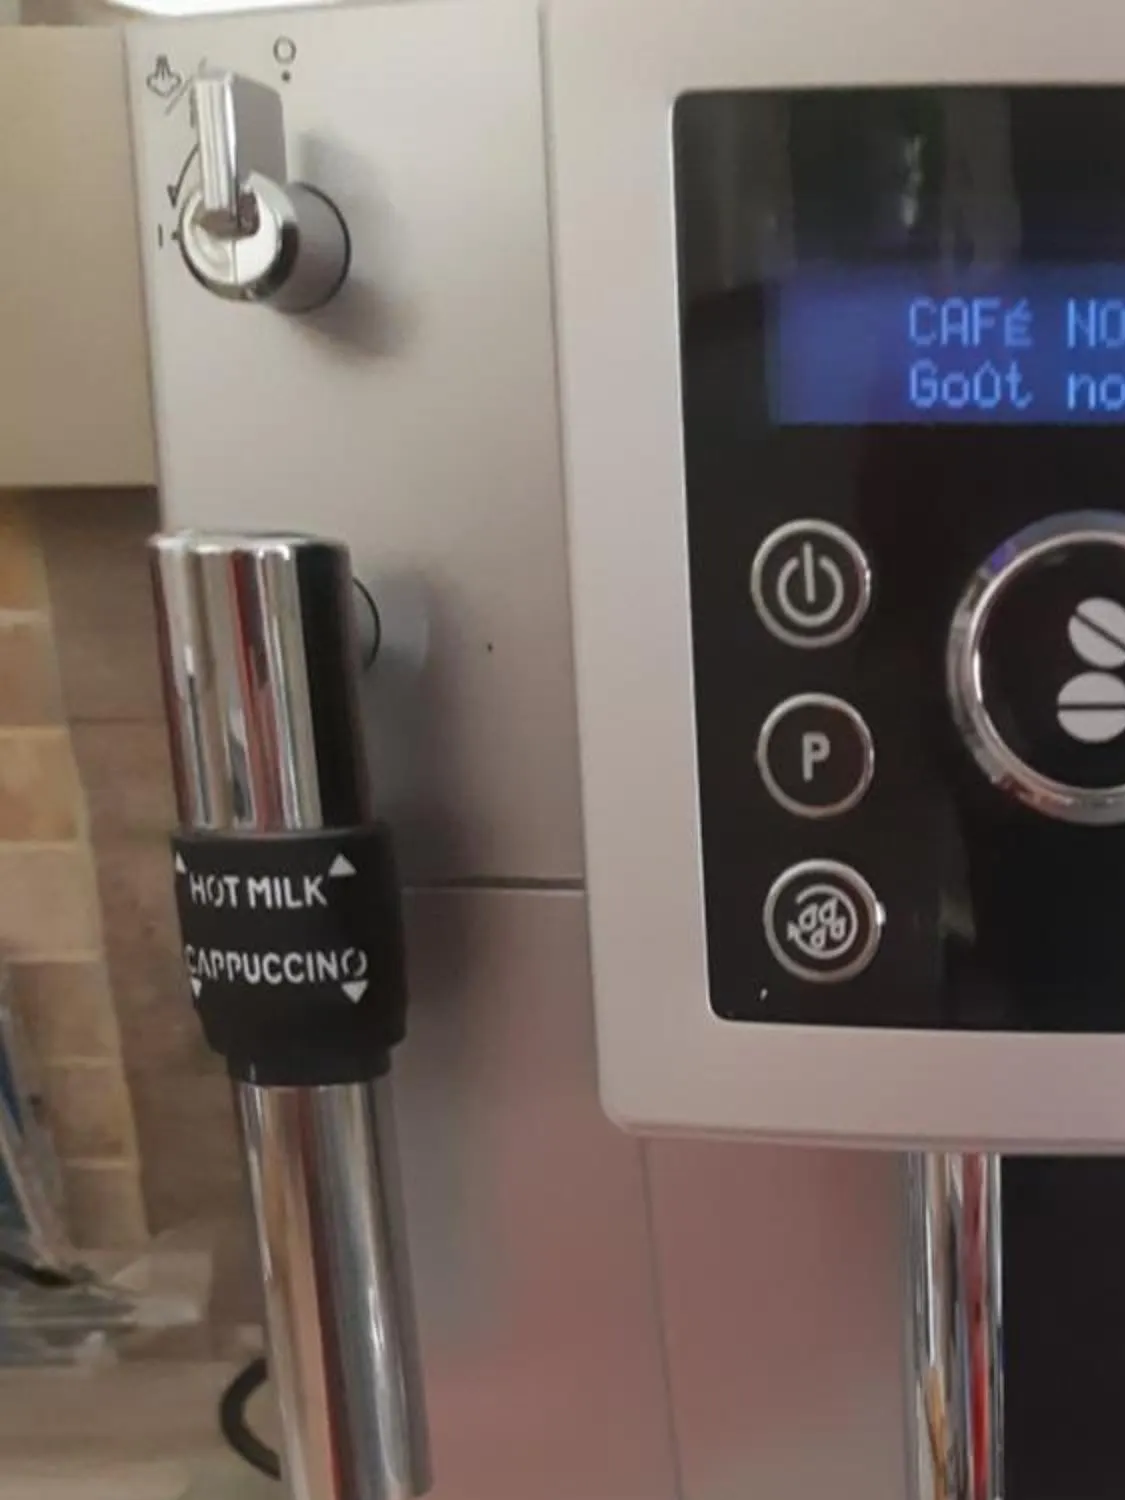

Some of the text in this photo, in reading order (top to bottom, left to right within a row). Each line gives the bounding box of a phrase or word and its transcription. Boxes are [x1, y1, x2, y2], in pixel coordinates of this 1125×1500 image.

[908, 359, 1034, 411] Goût
[802, 732, 831, 781] P
[189, 872, 328, 909] HOT MILK
[185, 944, 368, 985] CAPPUCCINO
